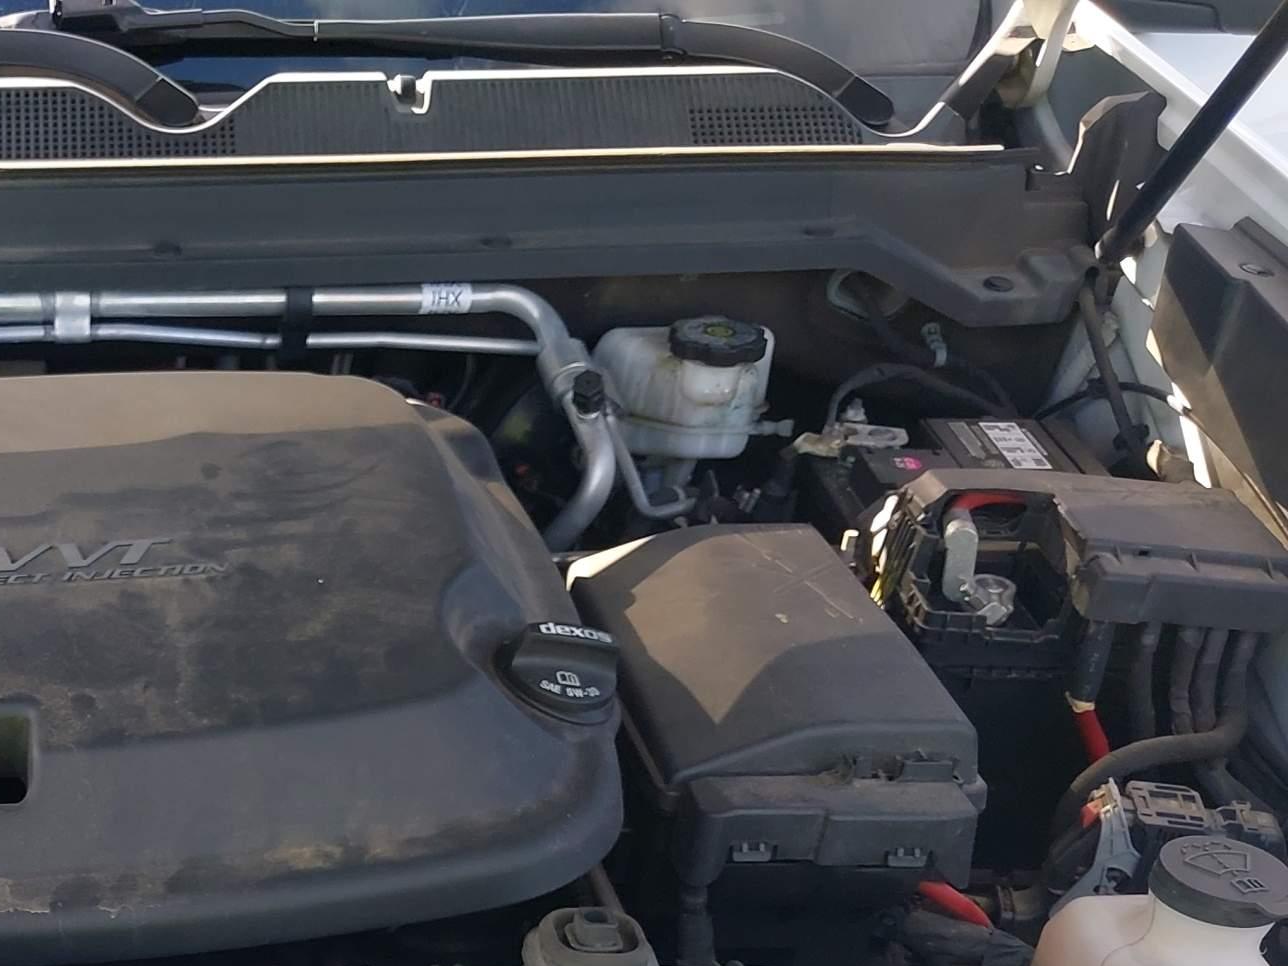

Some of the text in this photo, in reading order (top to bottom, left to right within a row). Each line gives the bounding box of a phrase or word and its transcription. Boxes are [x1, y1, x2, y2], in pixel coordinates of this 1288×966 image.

[63, 562, 230, 583] INJECTION
[538, 622, 613, 643] dexos
[539, 680, 562, 695] SAE
